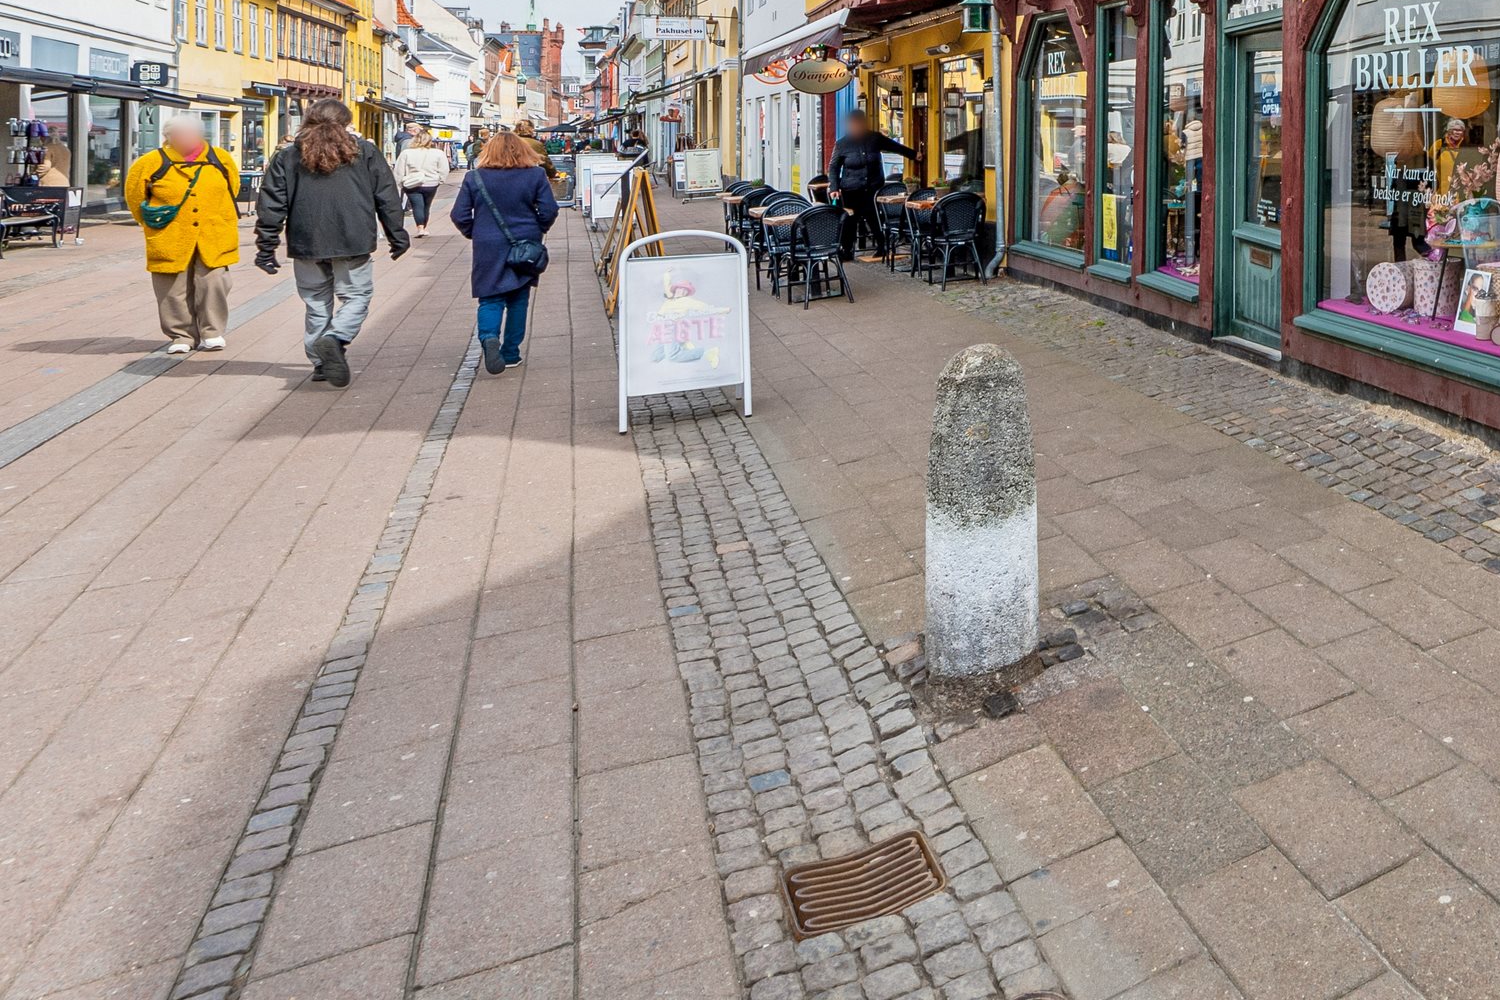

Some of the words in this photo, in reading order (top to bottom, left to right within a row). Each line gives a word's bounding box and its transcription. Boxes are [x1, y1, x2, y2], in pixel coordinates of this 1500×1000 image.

[1383, 1, 1442, 46] REX
[1047, 51, 1066, 75] REX
[1354, 45, 1477, 91] BRILLER
[793, 68, 846, 83] D'angelo
[1262, 103, 1279, 114] OPEN
[1402, 165, 1420, 181] kun
[1422, 166, 1437, 182] det
[1373, 184, 1400, 201] bedste
[1401, 190, 1411, 202] er
[1412, 188, 1432, 207] godt
[1435, 190, 1454, 206] nok
